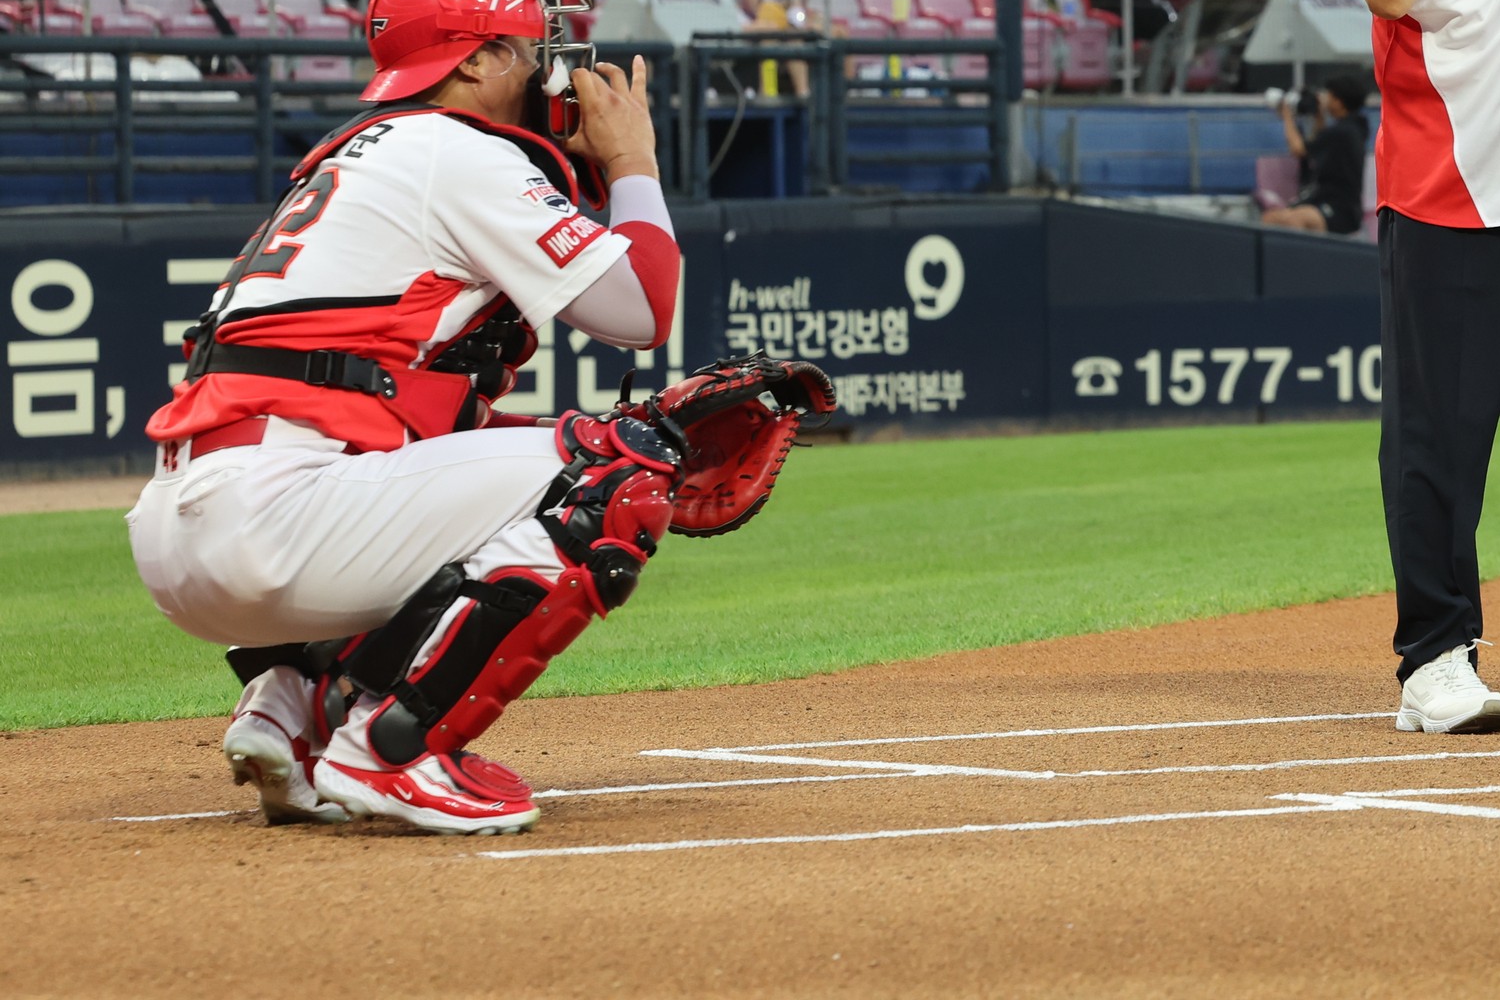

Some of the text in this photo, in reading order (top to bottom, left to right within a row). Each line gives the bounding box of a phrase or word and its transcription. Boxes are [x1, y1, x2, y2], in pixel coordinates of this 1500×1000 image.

[521, 185, 560, 203] TIGE
[7, 258, 126, 440] 음,
[724, 306, 910, 360] 국민건강보험
[770, 369, 967, 417] 제주지역본부
